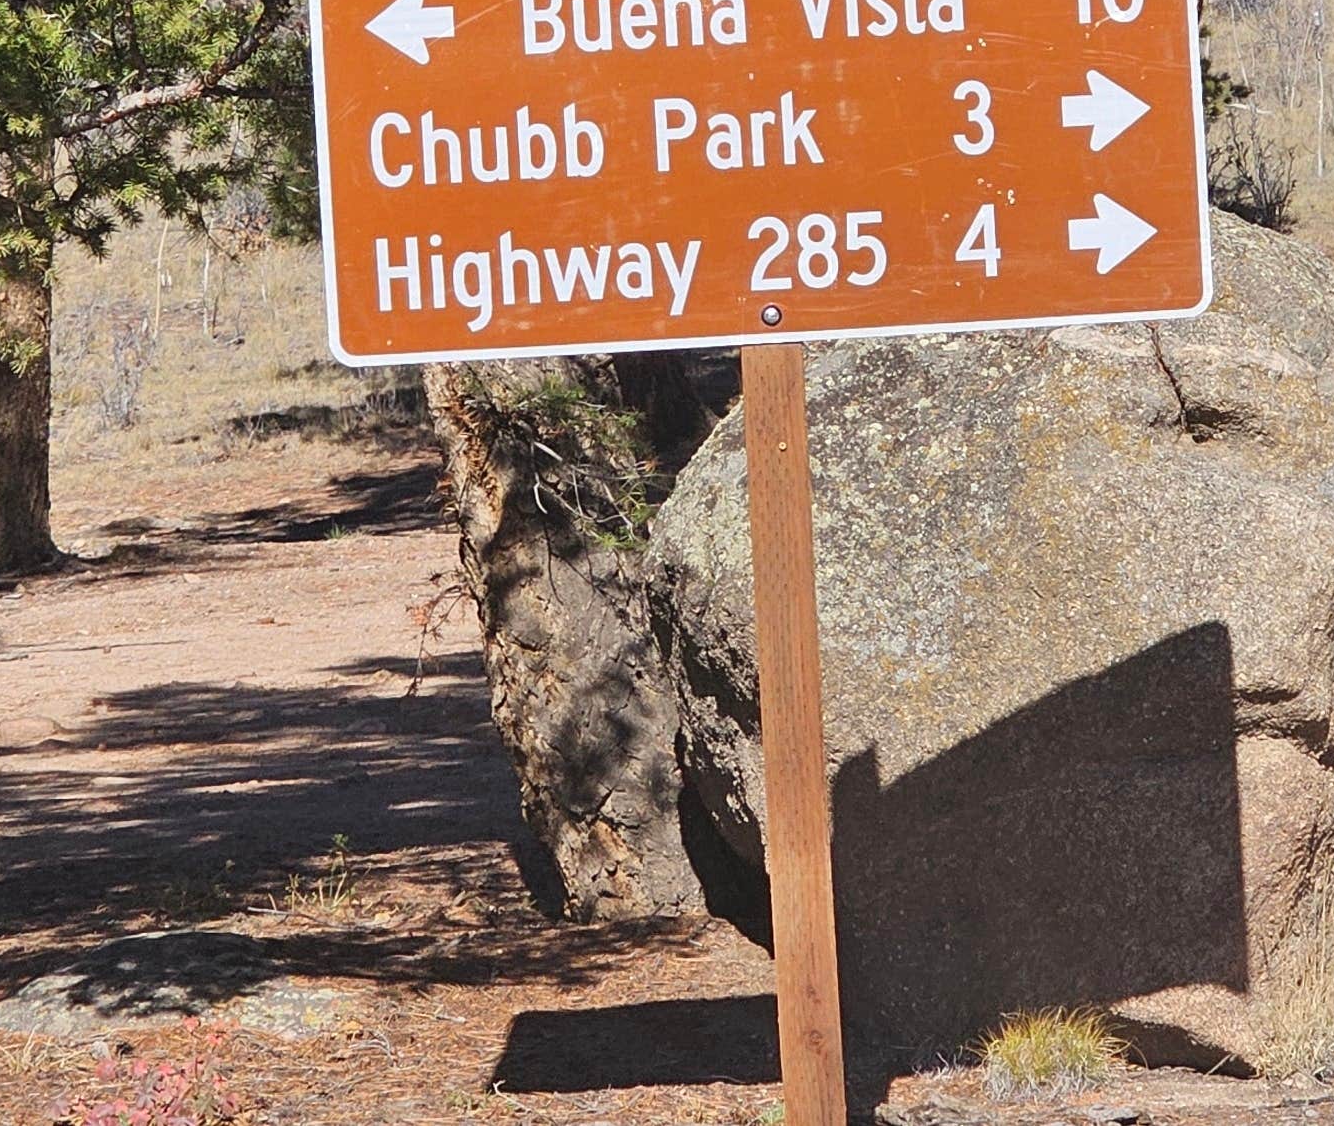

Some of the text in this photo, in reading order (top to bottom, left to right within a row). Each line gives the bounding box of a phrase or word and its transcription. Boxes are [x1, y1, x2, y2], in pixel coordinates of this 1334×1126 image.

[369, 79, 995, 189] Chubb Park 3
[375, 203, 1002, 333] Highway 285 4
